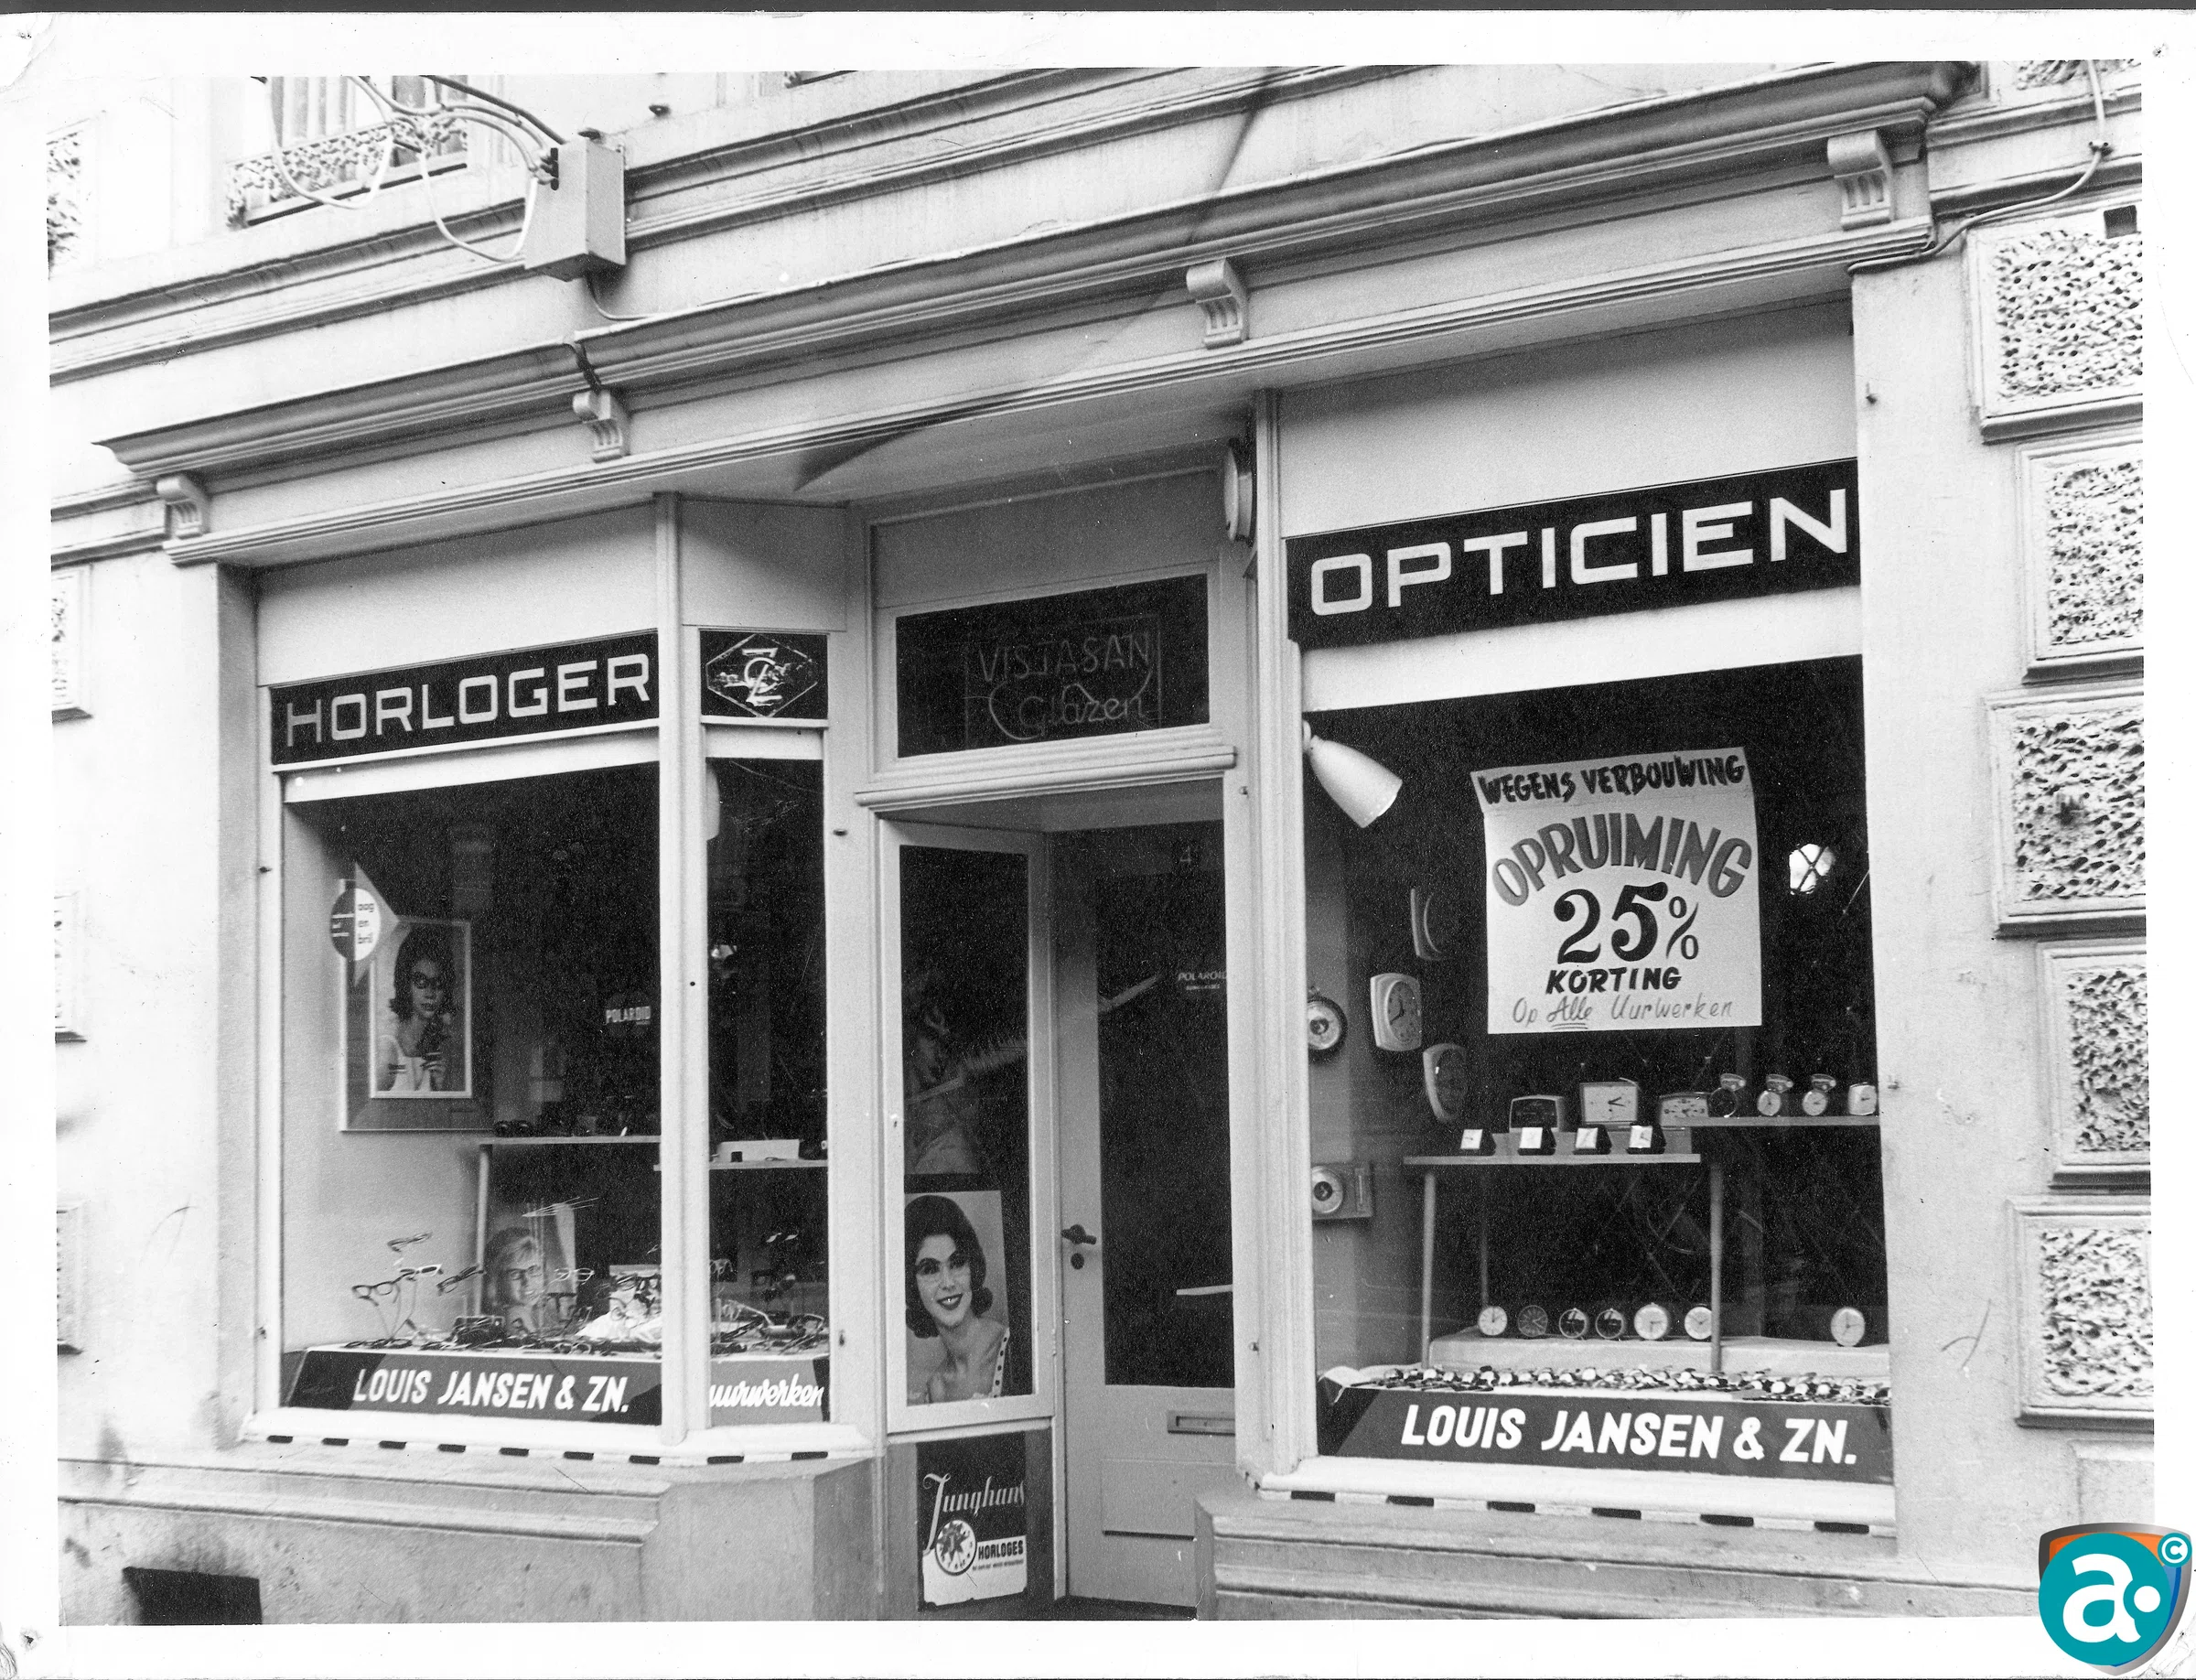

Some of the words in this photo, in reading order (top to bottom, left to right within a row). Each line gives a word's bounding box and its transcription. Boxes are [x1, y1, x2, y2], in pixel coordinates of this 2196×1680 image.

[1311, 489, 1847, 617] OPTICIEN
[286, 652, 651, 748] HORLOGER
[1477, 770, 1577, 805] WEGENS
[1580, 754, 1746, 796] VERBOUWING
[1491, 812, 1752, 907] OPRUIMING
[1554, 881, 1700, 965] 25%
[1545, 966, 1683, 995] KORTING
[1512, 996, 1539, 1028] Op
[1546, 995, 1593, 1021] Alle
[352, 1367, 433, 1405] LOUIS
[437, 1370, 554, 1411] JANSEN
[554, 1374, 576, 1412] &
[581, 1374, 630, 1413] ZN.
[1400, 1404, 1526, 1450] LOUIS
[1540, 1409, 1724, 1459] JANSEN
[1732, 1415, 1765, 1460] &
[1778, 1417, 1858, 1466] ZN.
[977, 1539, 1025, 1561] HORLOGES
